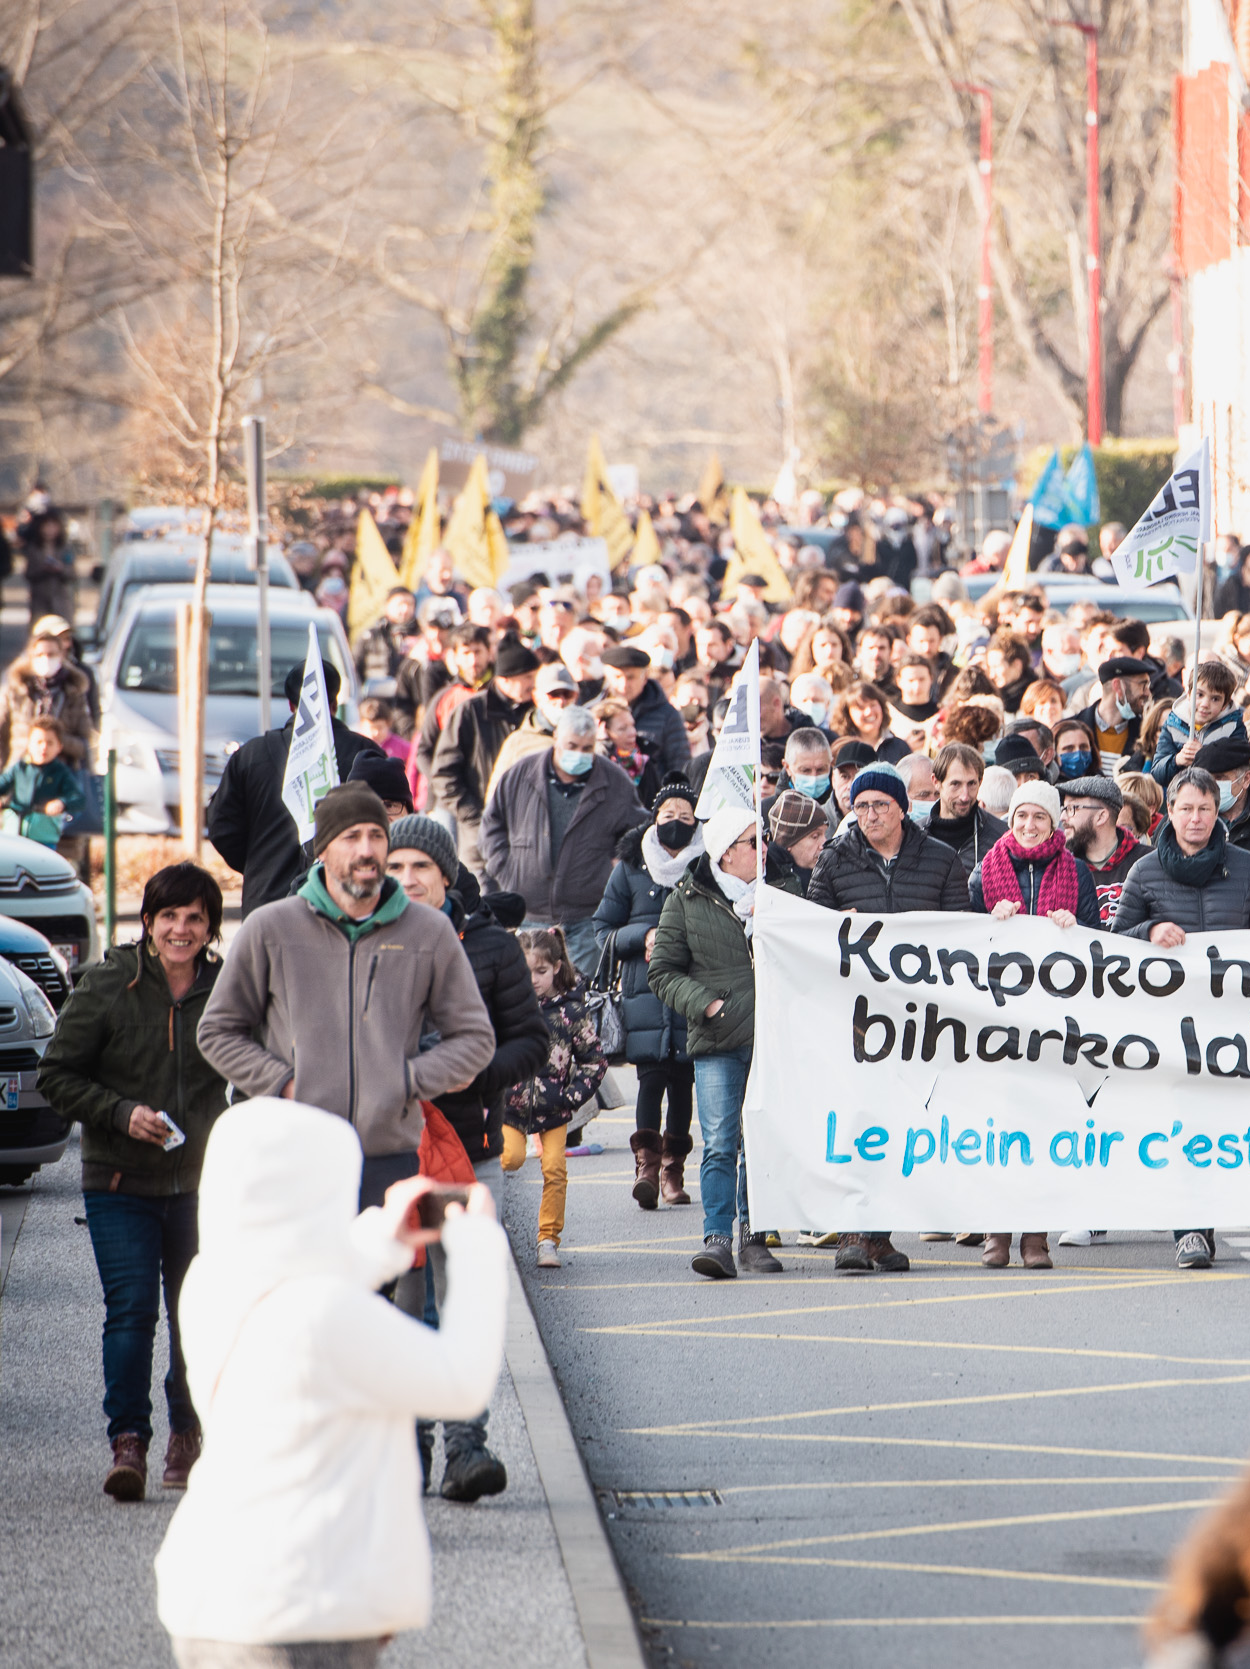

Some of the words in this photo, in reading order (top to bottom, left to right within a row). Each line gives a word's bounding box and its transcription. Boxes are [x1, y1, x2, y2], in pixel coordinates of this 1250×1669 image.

[838, 917, 1186, 1006] Kanpoko
[852, 995, 1160, 1070] biharko
[825, 1110, 890, 1165] Le
[901, 1114, 1035, 1179] plein
[1048, 1118, 1125, 1169] air
